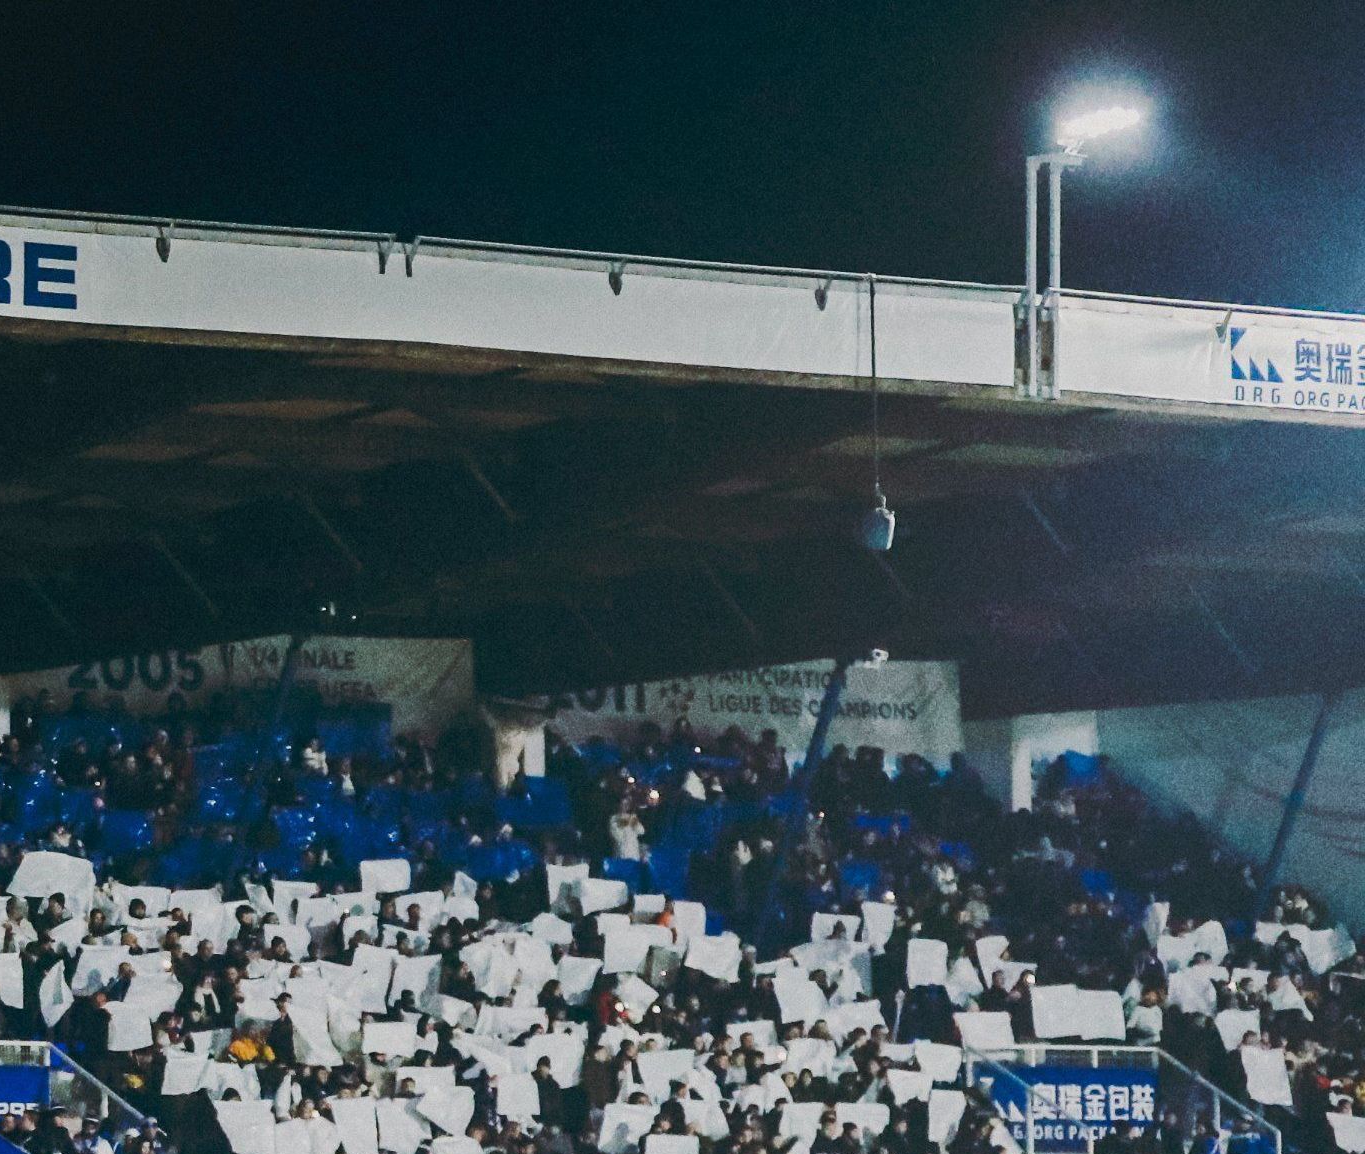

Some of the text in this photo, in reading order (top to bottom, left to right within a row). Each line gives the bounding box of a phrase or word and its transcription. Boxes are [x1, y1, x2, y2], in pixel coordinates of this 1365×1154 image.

[1295, 390, 1330, 408] ORG
[1337, 393, 1365, 411] PA
[302, 649, 356, 671] NALE
[708, 694, 919, 721] LIGUE DES CAMPIONS
